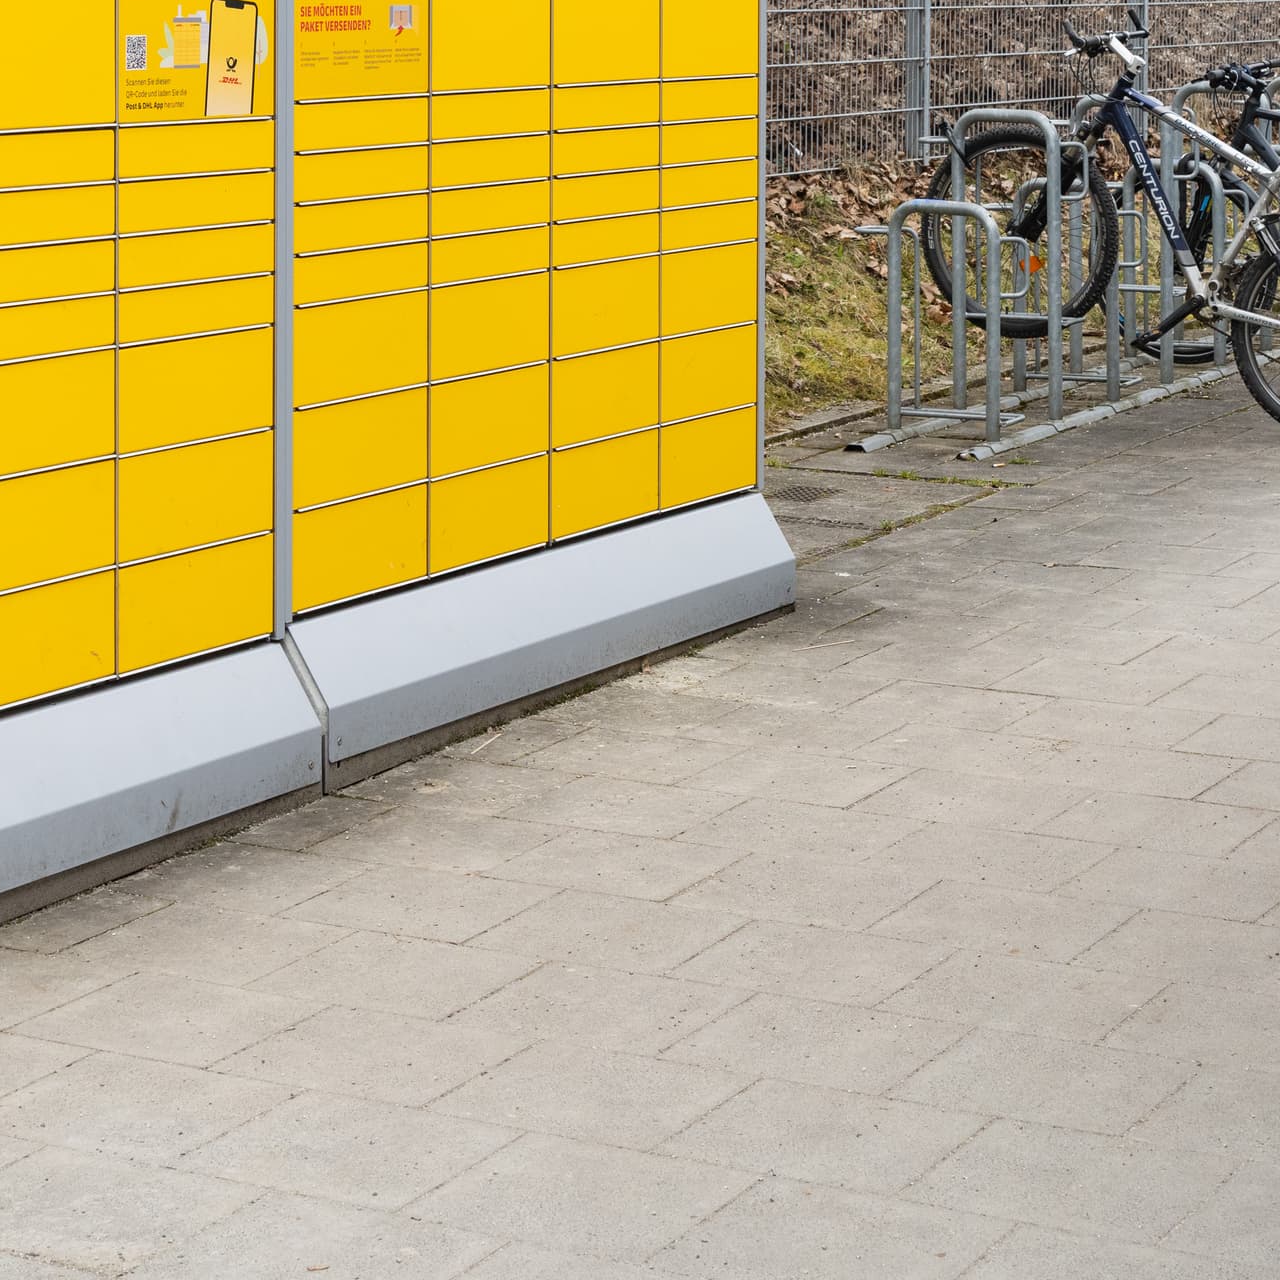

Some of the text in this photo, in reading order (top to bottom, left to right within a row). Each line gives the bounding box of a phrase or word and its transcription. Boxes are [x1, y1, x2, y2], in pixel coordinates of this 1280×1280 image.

[300, 3, 362, 17] SIE MÖCHTEN EIN
[300, 20, 372, 33] PAKET VERSENDEN?
[126, 102, 137, 110] Post
[154, 102, 164, 111] App
[1128, 139, 1180, 240] CENTURION
